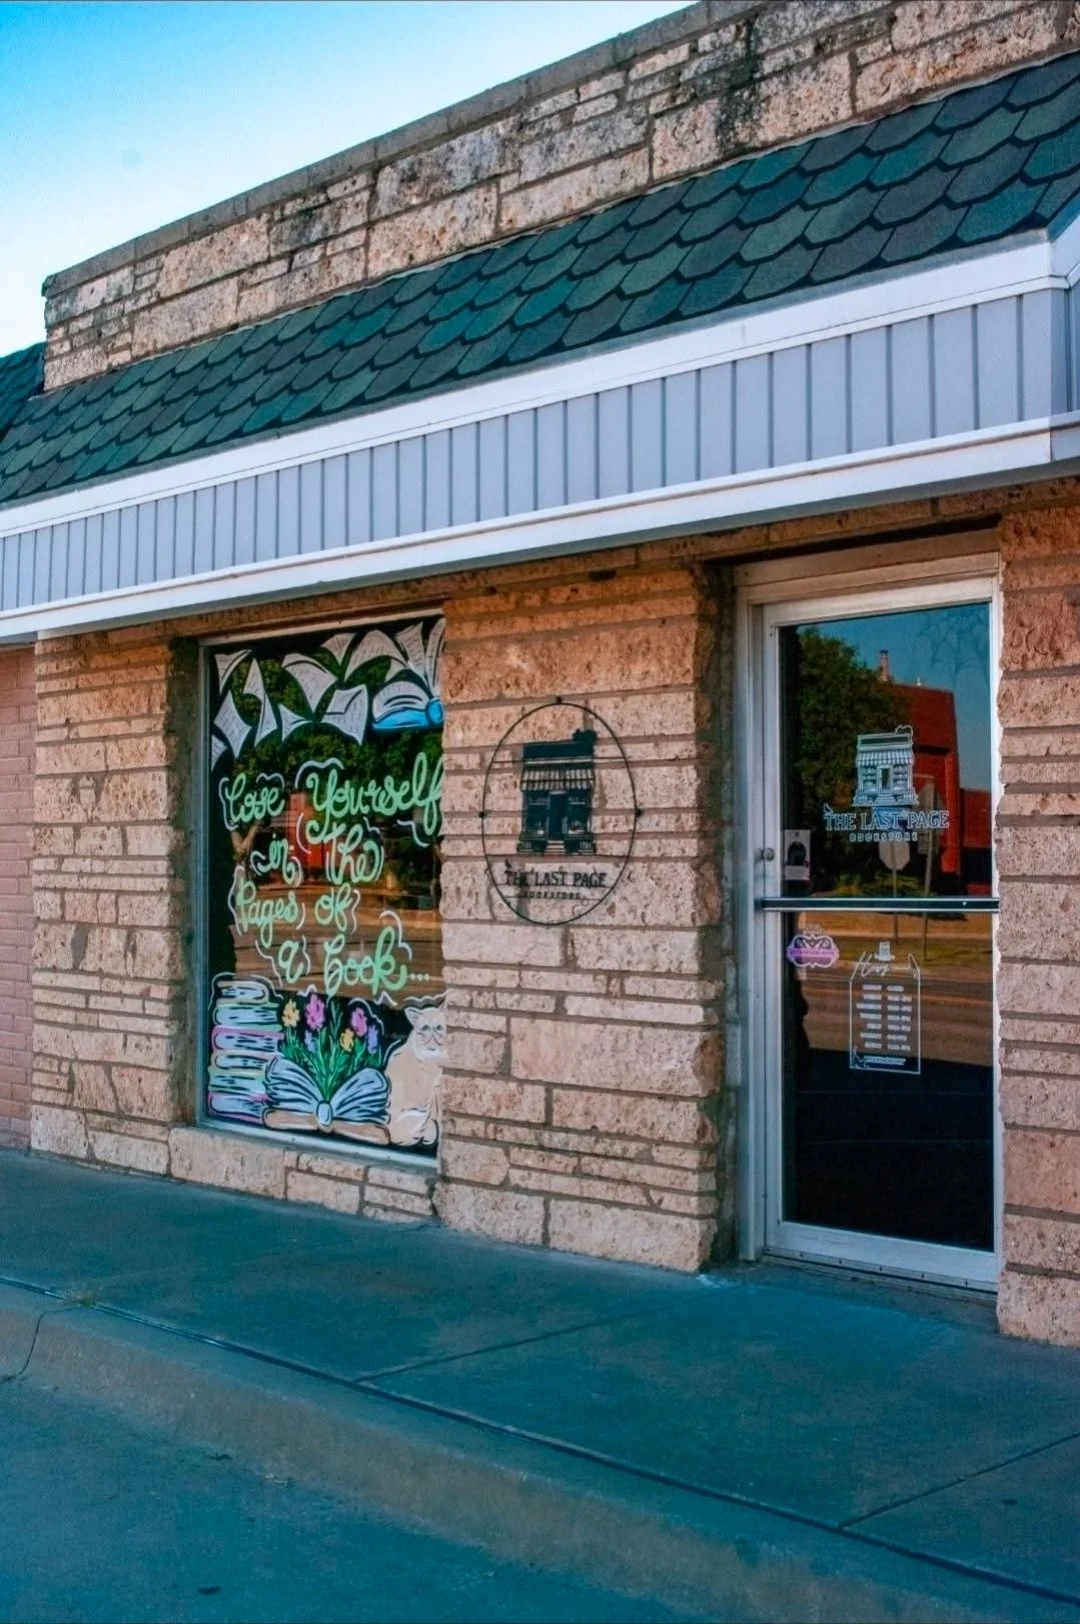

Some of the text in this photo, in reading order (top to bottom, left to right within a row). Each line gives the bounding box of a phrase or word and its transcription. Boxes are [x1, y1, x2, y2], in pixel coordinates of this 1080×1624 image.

[305, 752, 443, 844] Yourself
[823, 810, 950, 831] THE LAST PAGE
[849, 831, 919, 843] BOOKSTORE
[257, 833, 296, 885] in
[503, 870, 607, 888] THE LAST PAGE
[315, 882, 353, 932] of
